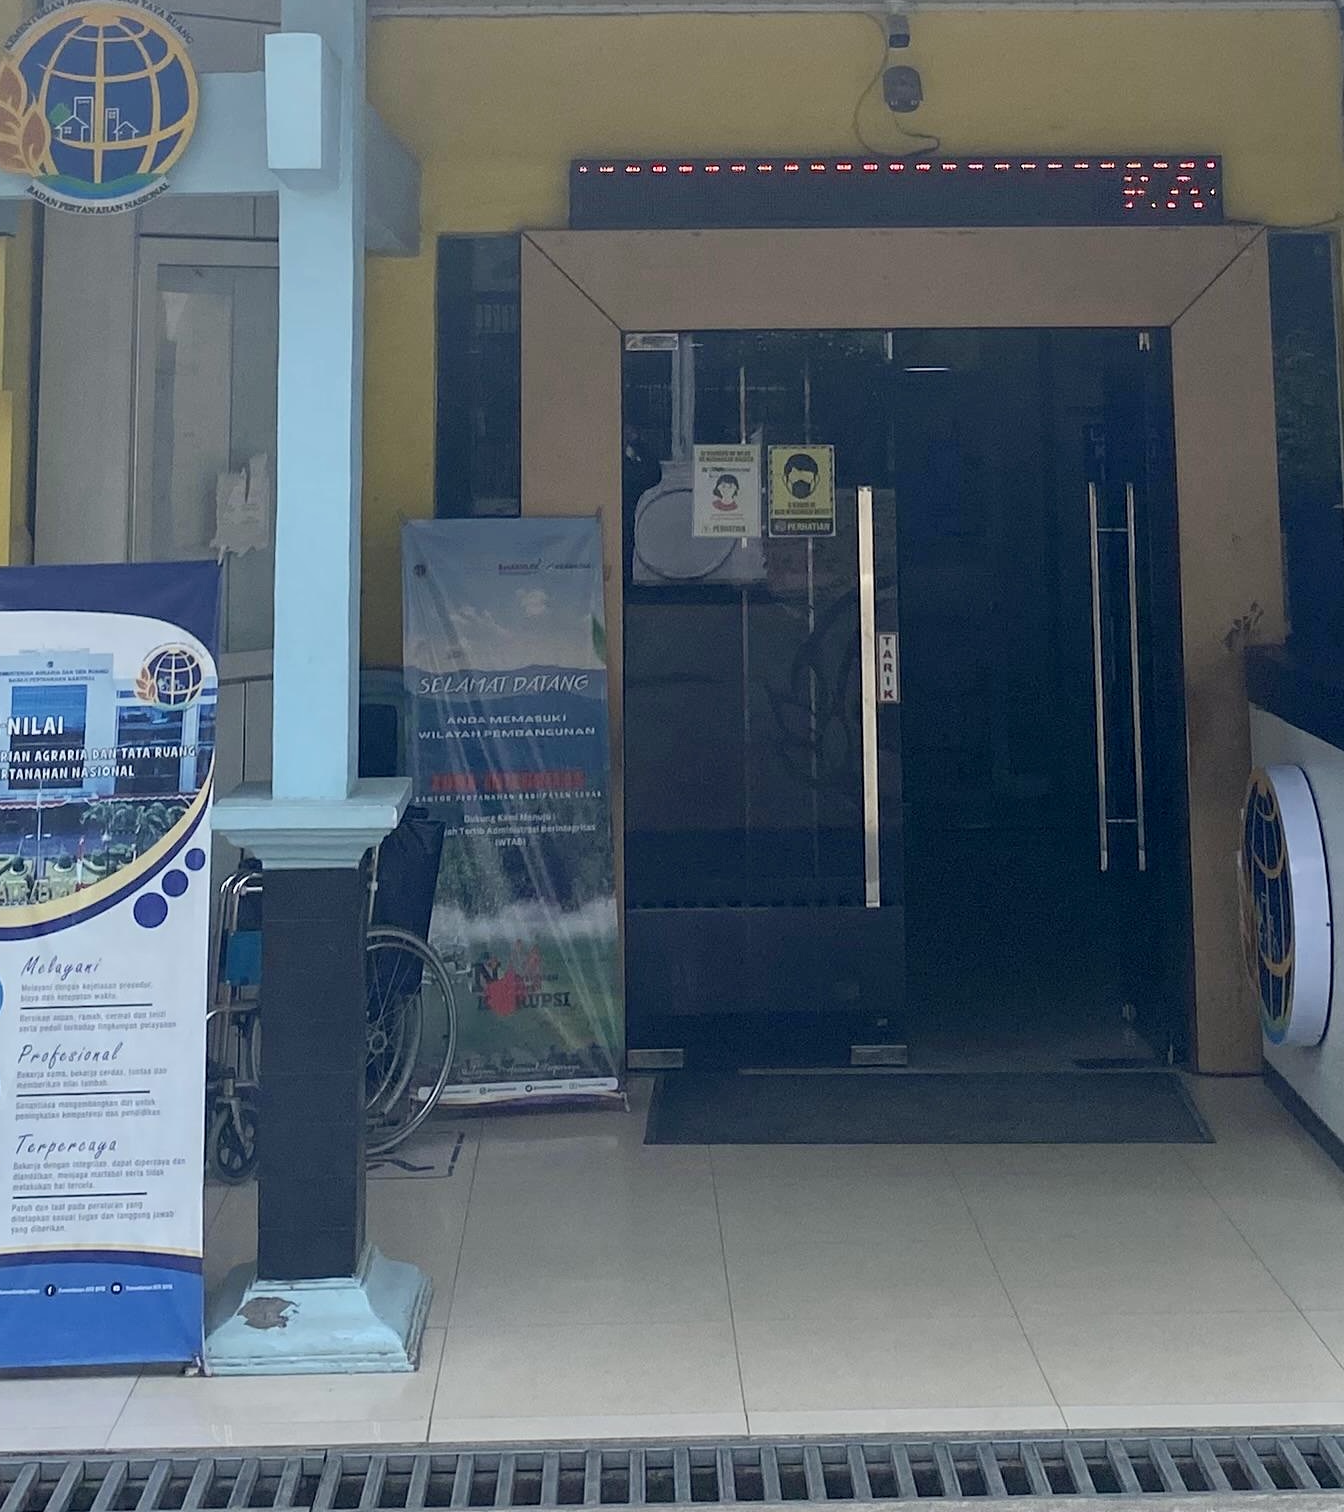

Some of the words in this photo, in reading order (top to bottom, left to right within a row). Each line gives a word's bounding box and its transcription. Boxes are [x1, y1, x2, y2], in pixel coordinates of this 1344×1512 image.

[141, 0, 165, 18] TATA
[26, 185, 58, 208] BADAN
[124, 183, 171, 208] NASIONAL
[881, 636, 894, 700] TARIK
[418, 675, 509, 694] SELAMAT
[512, 674, 590, 692] DATANG
[446, 714, 487, 725] ANDA
[489, 712, 567, 725] MEMASUKI
[418, 727, 481, 740] WILAYAH
[484, 726, 596, 738] PEMBANGUNAN
[34, 748, 88, 762] AGRARIA
[92, 748, 117, 760] DAN
[121, 747, 151, 760] TATA
[154, 745, 196, 759] RUANG
[71, 764, 135, 779] NASIONAL
[20, 954, 103, 981] Melayani
[17, 1041, 124, 1070] Profesional
[15, 1133, 117, 1160] Terpercaya
